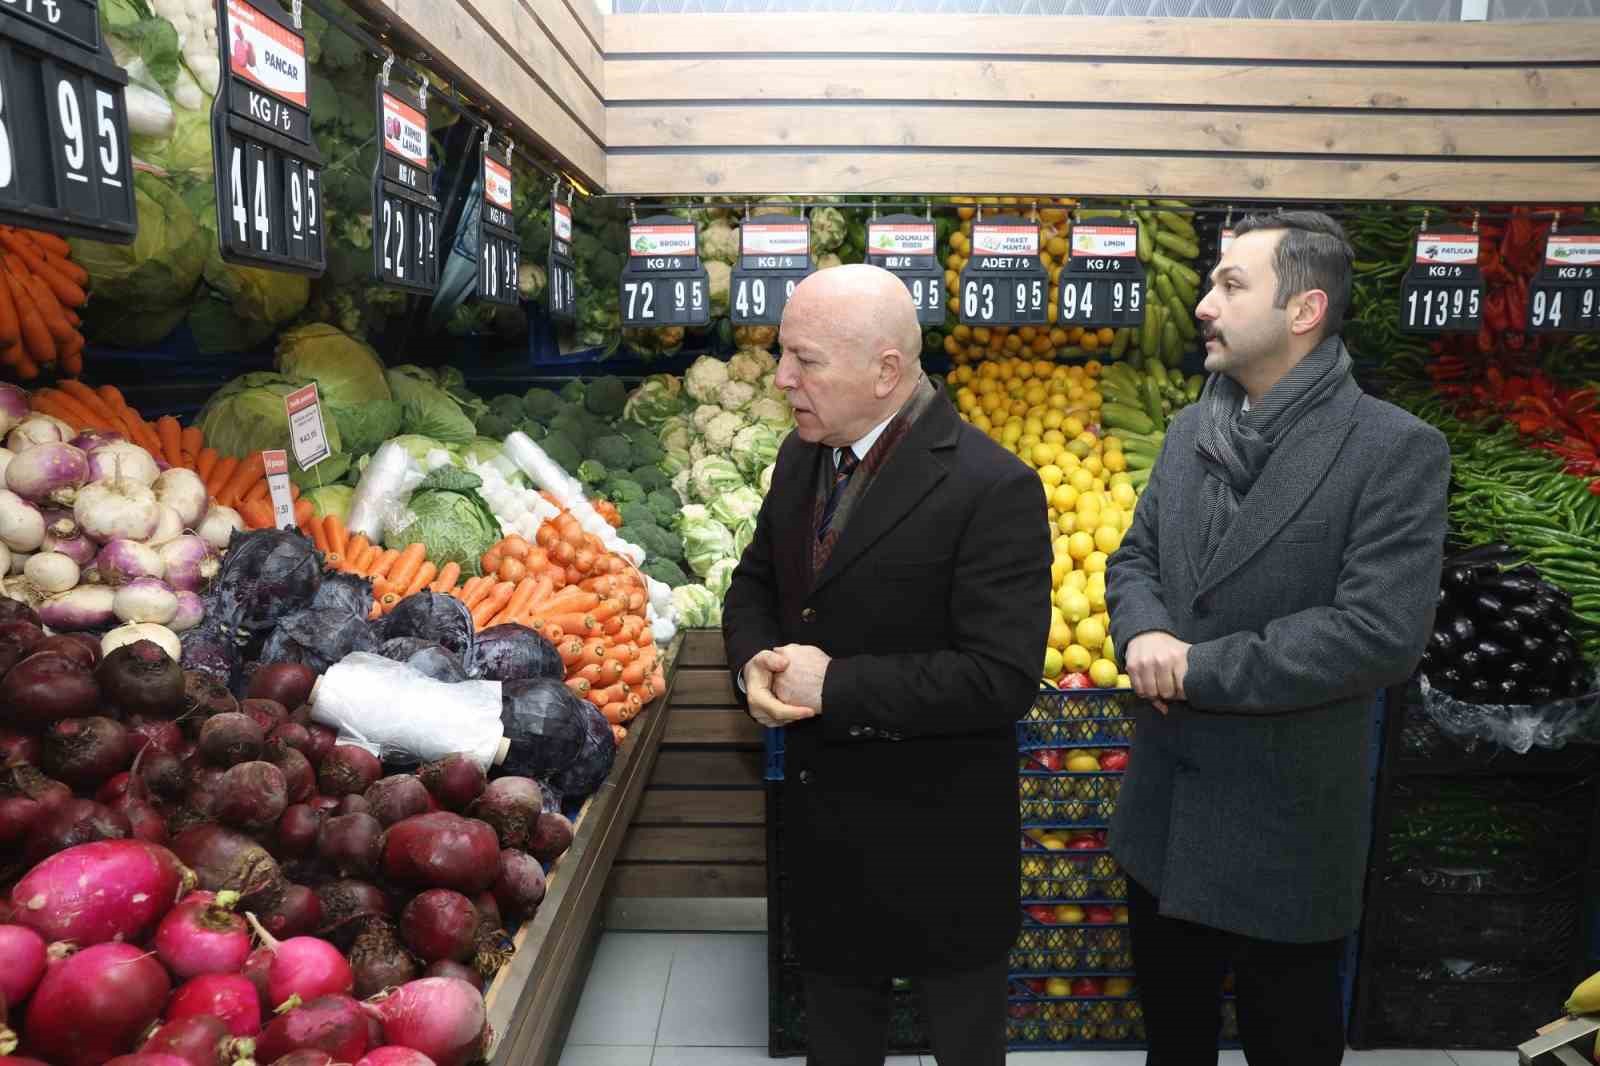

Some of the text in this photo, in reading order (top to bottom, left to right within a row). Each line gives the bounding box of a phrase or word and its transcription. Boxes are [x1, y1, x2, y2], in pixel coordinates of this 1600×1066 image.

[264, 50, 299, 81] PANCAR
[57, 79, 120, 178] 95
[402, 136, 423, 156] LAHANA
[231, 147, 317, 250] 44 95
[383, 200, 404, 278] 22
[1440, 247, 1474, 256] PATLICAN
[624, 281, 703, 320] 72 95
[735, 279, 766, 318] 49
[913, 279, 939, 307] 95
[965, 280, 1041, 320] 63 95
[1063, 281, 1140, 320] 94 95
[1408, 289, 1480, 326] 113 95
[1532, 289, 1600, 327] 94 9
